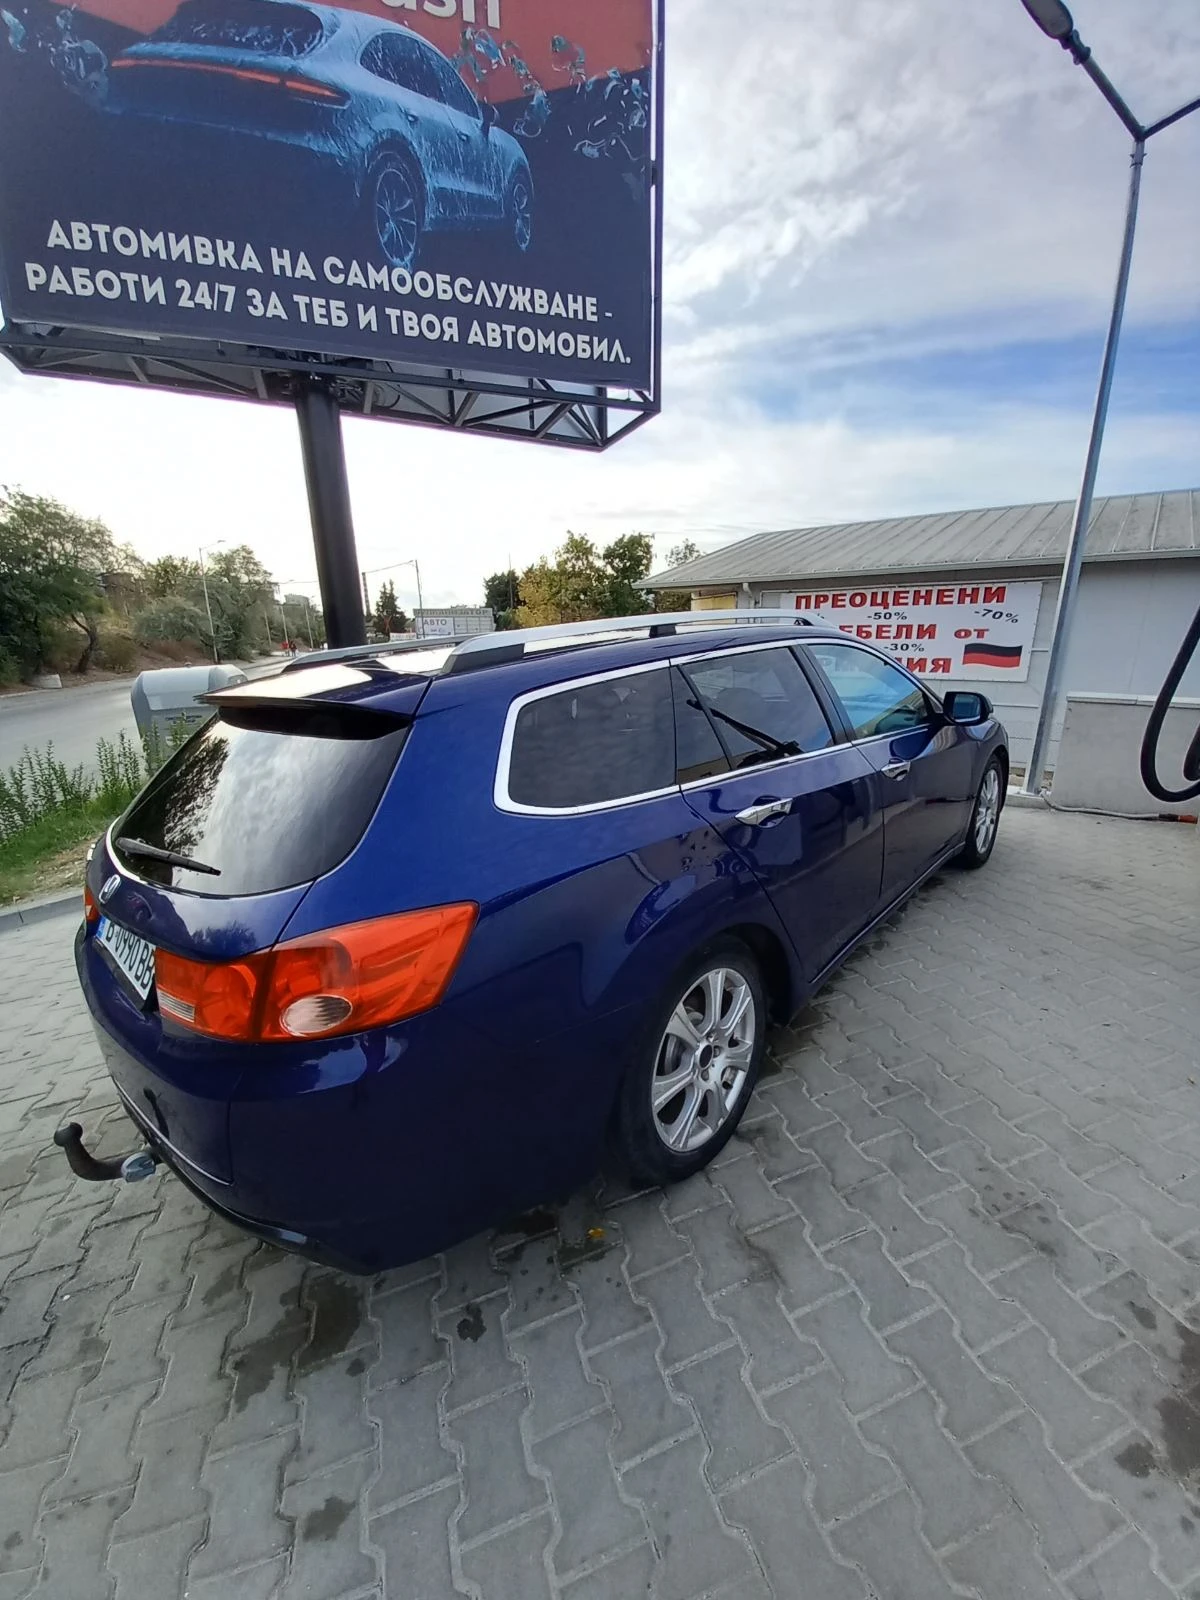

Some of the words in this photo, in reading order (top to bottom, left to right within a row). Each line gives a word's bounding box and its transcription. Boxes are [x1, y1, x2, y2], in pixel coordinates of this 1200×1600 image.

[47, 219, 263, 273] АВТОМИВКА
[271, 247, 317, 281] НА
[323, 256, 598, 322] САМООБСЛУЖВАНЕ
[24, 262, 167, 305] РАБОТИ
[175, 278, 236, 313] 24/7
[246, 288, 289, 320] ЗА
[292, 294, 349, 327] ТЕБ
[357, 303, 378, 332] И
[384, 307, 459, 343] ТВОЯ
[467, 319, 631, 364] АВТОМОБИЛ.
[795, 586, 1006, 610] ПРЕОЦЕНЕНИ
[867, 611, 908, 621] -50%
[974, 608, 1019, 624] -70%
[838, 623, 937, 640] ЕБЕЛИ
[883, 643, 925, 652] -30%
